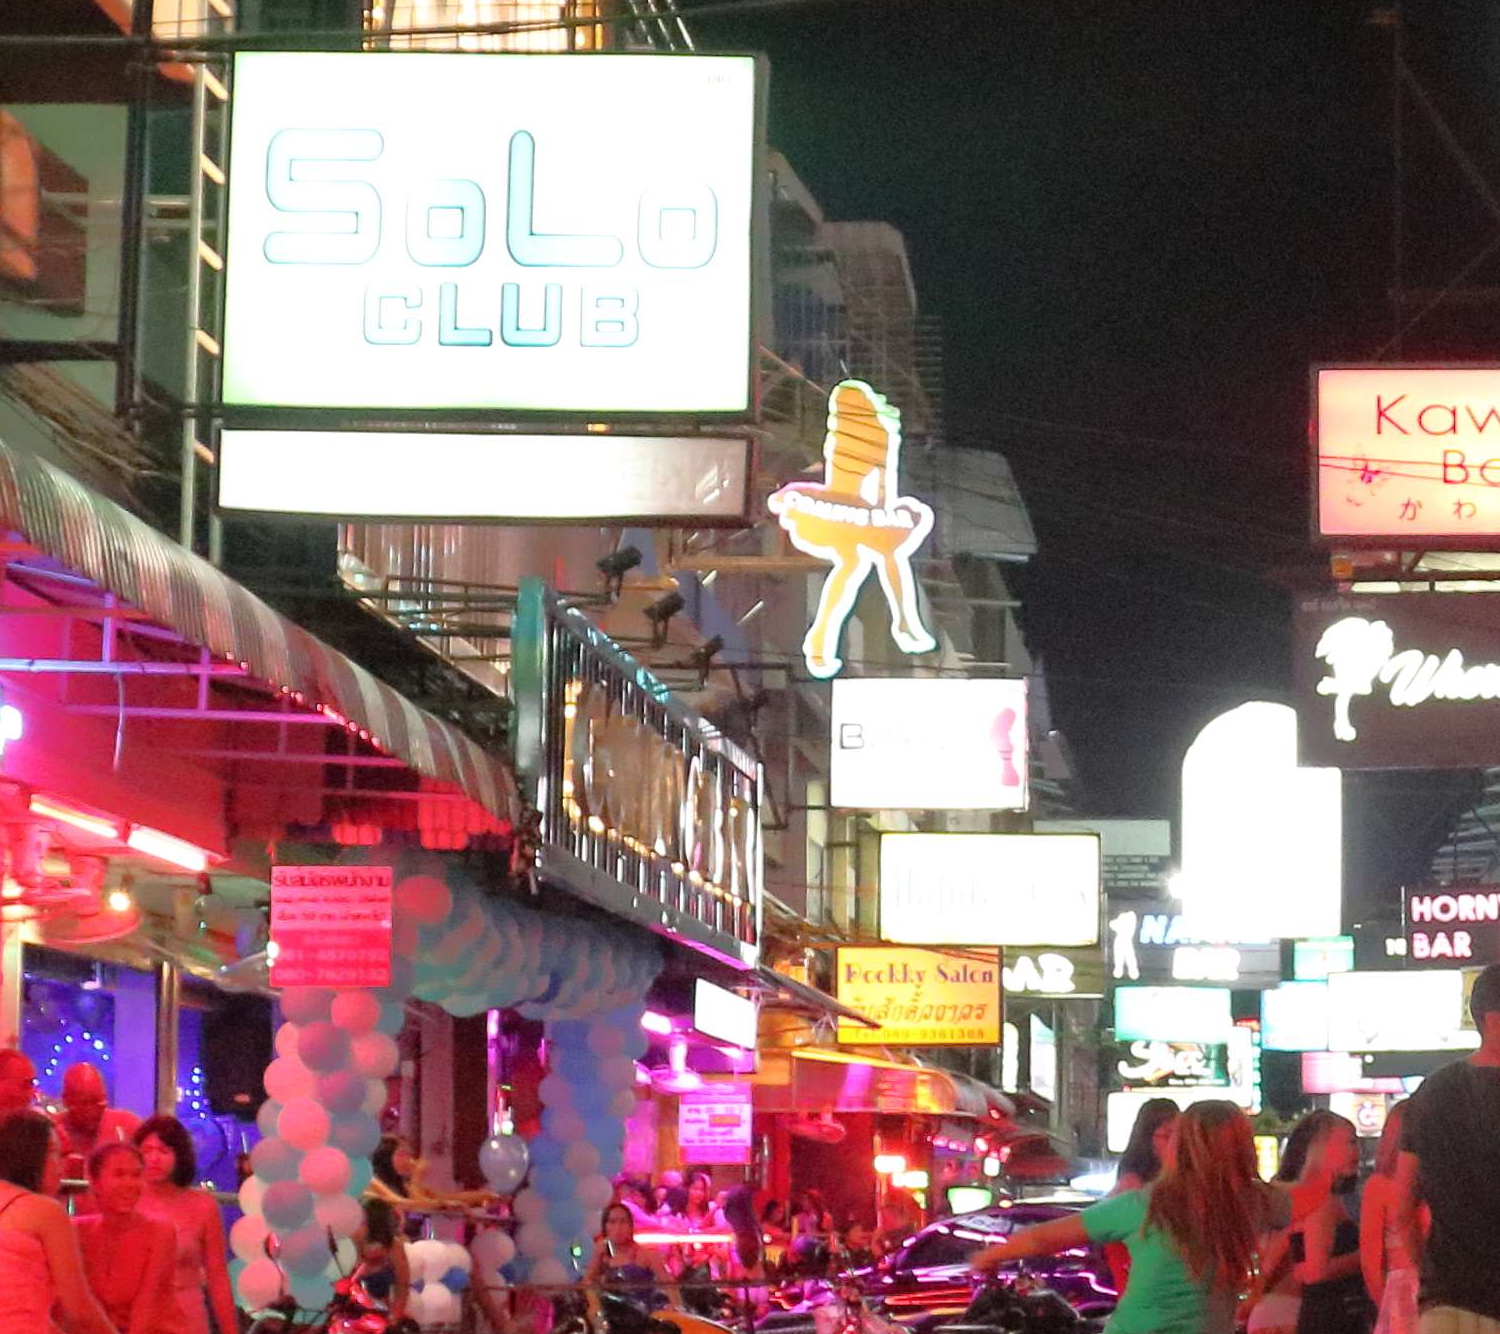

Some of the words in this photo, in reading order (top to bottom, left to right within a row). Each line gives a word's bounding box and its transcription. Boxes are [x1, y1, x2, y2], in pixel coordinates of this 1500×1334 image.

[262, 127, 719, 269] SoLo
[362, 281, 640, 348] CLUB
[1412, 931, 1472, 959] BAR
[936, 962, 994, 985] Salon
